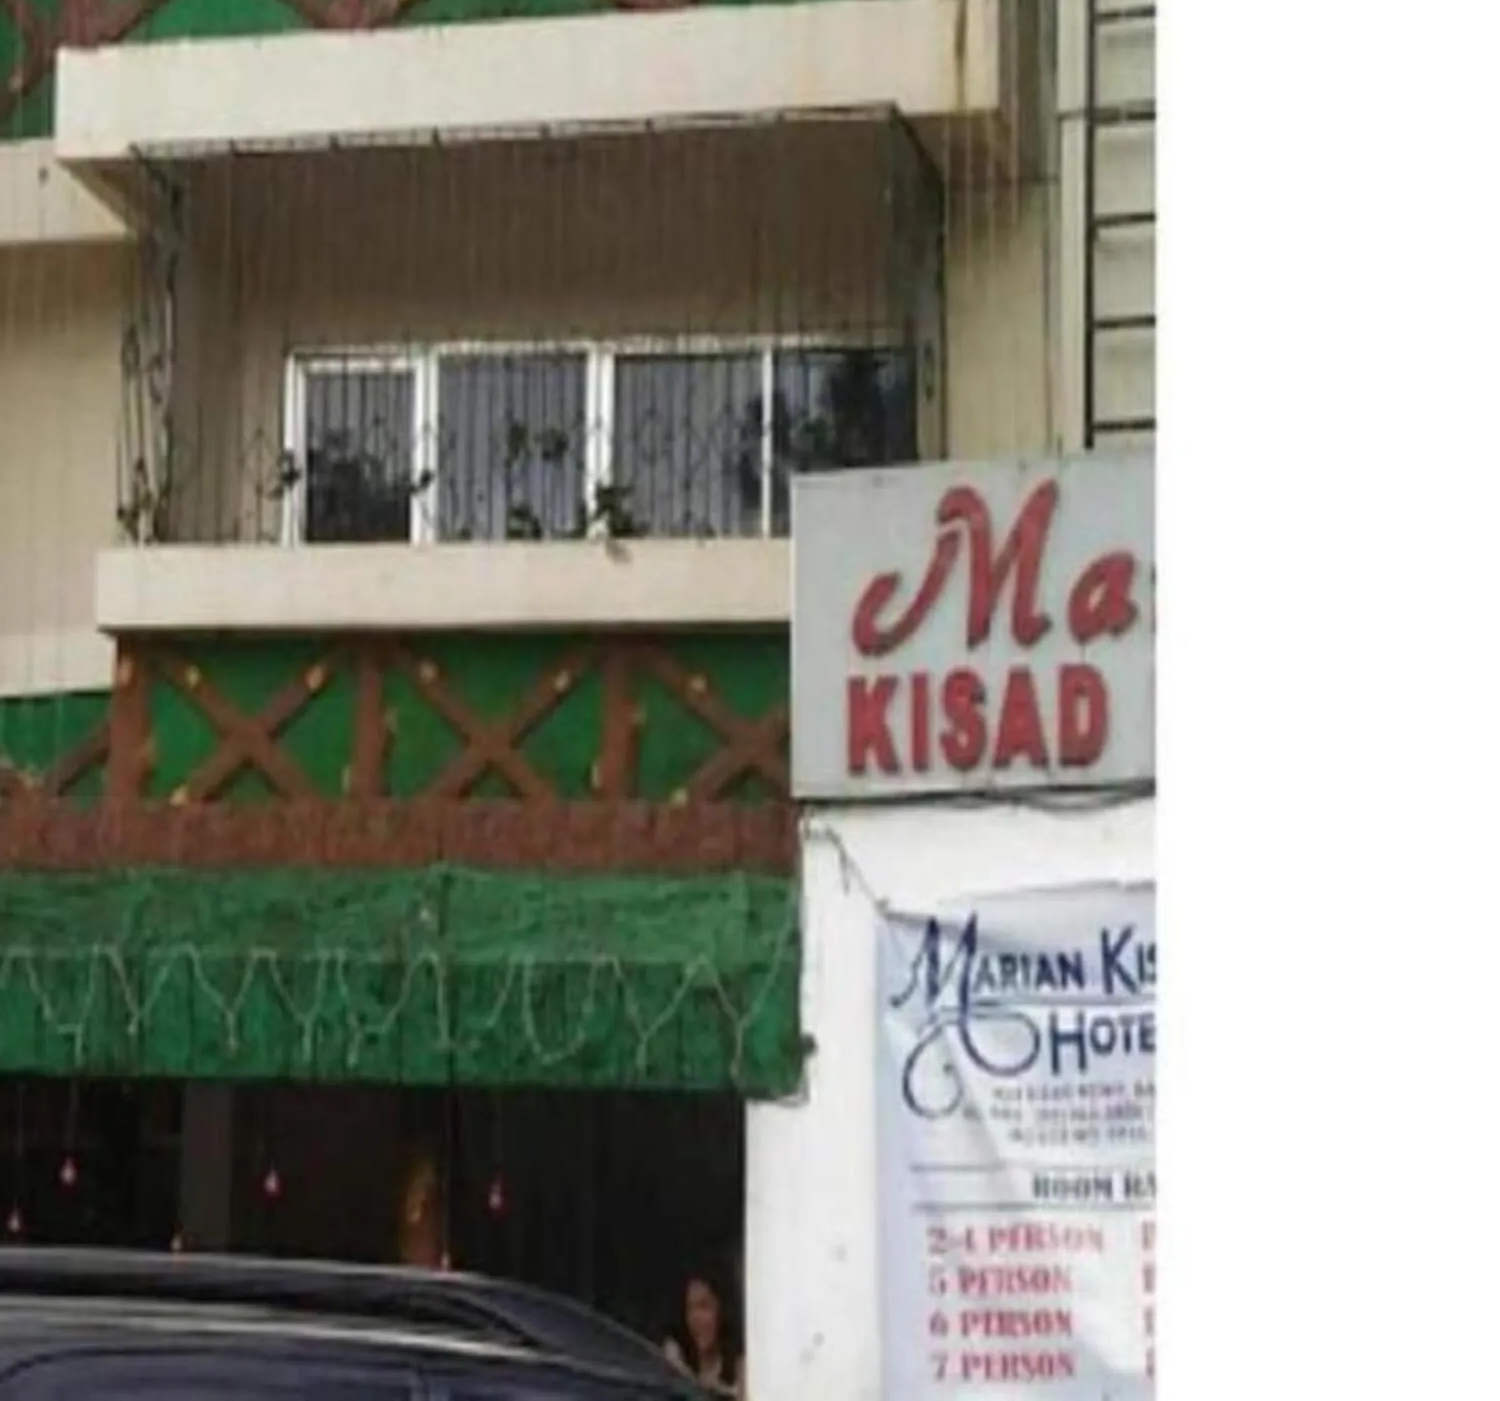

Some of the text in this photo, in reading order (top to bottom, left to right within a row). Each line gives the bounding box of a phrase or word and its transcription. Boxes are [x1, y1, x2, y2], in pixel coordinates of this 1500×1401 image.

[851, 478, 1155, 657] Ma
[846, 664, 1109, 777] KISAD
[888, 910, 1086, 1007] MARIAN
[988, 1224, 1103, 1254] PERSON
[957, 1265, 1073, 1296] PERSON
[929, 1308, 1072, 1338] 6 PERSON
[931, 1351, 1075, 1382] 7 PERSON
